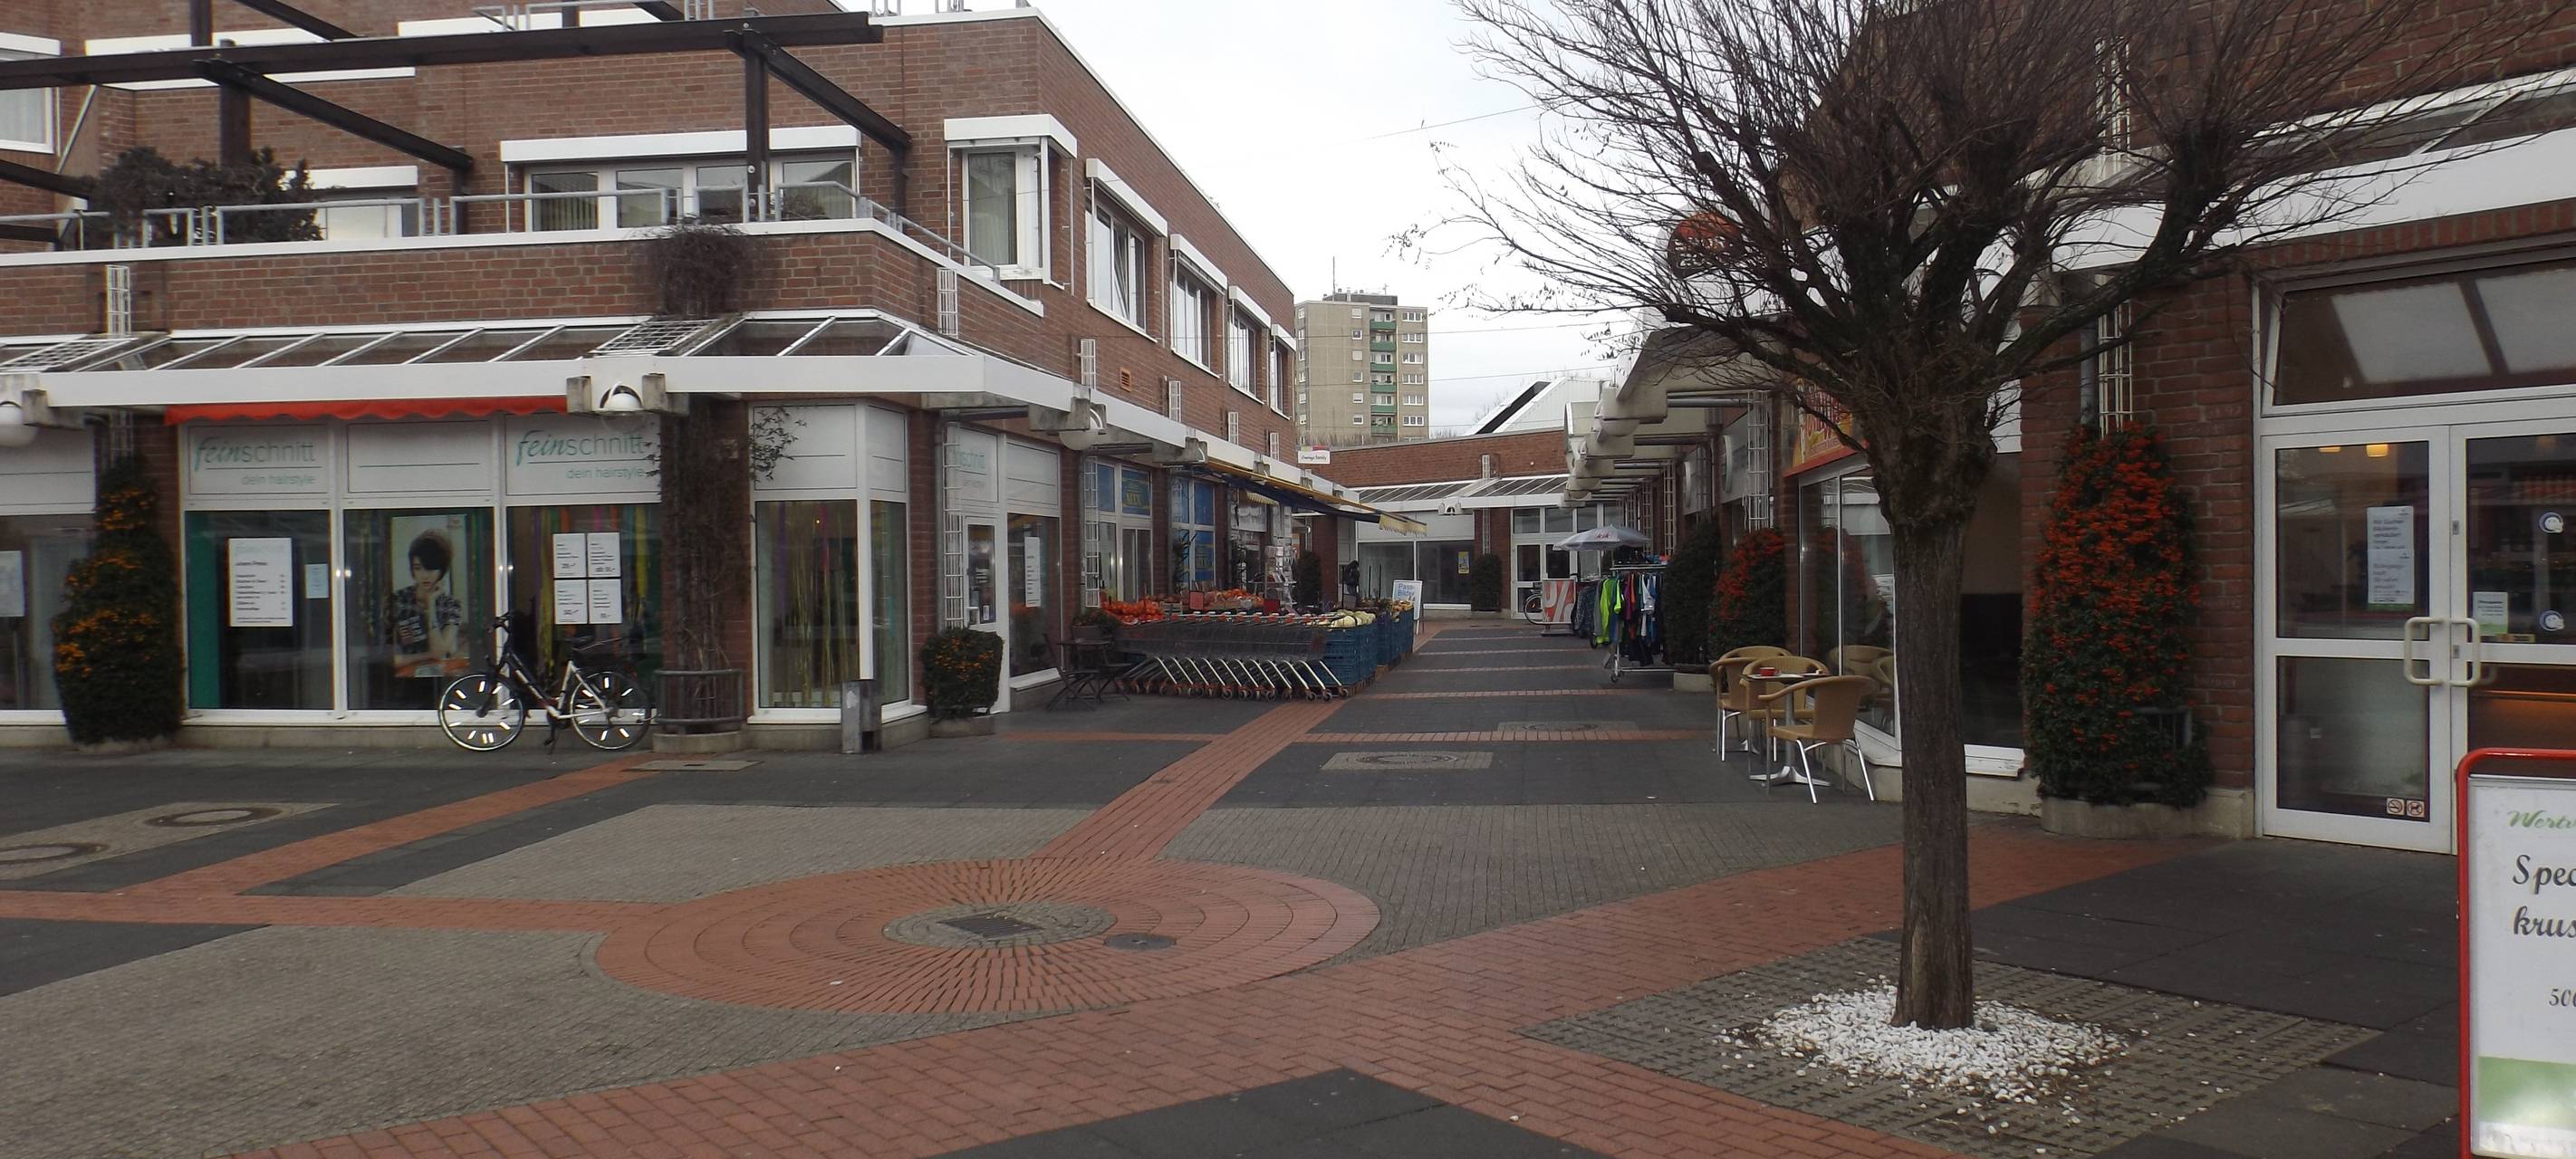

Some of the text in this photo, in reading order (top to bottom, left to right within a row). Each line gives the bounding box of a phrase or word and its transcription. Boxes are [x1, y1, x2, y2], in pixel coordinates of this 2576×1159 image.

[193, 436, 316, 472] feinschnitt
[515, 429, 645, 466] feinschnitt
[567, 466, 645, 480] dein hairstyle
